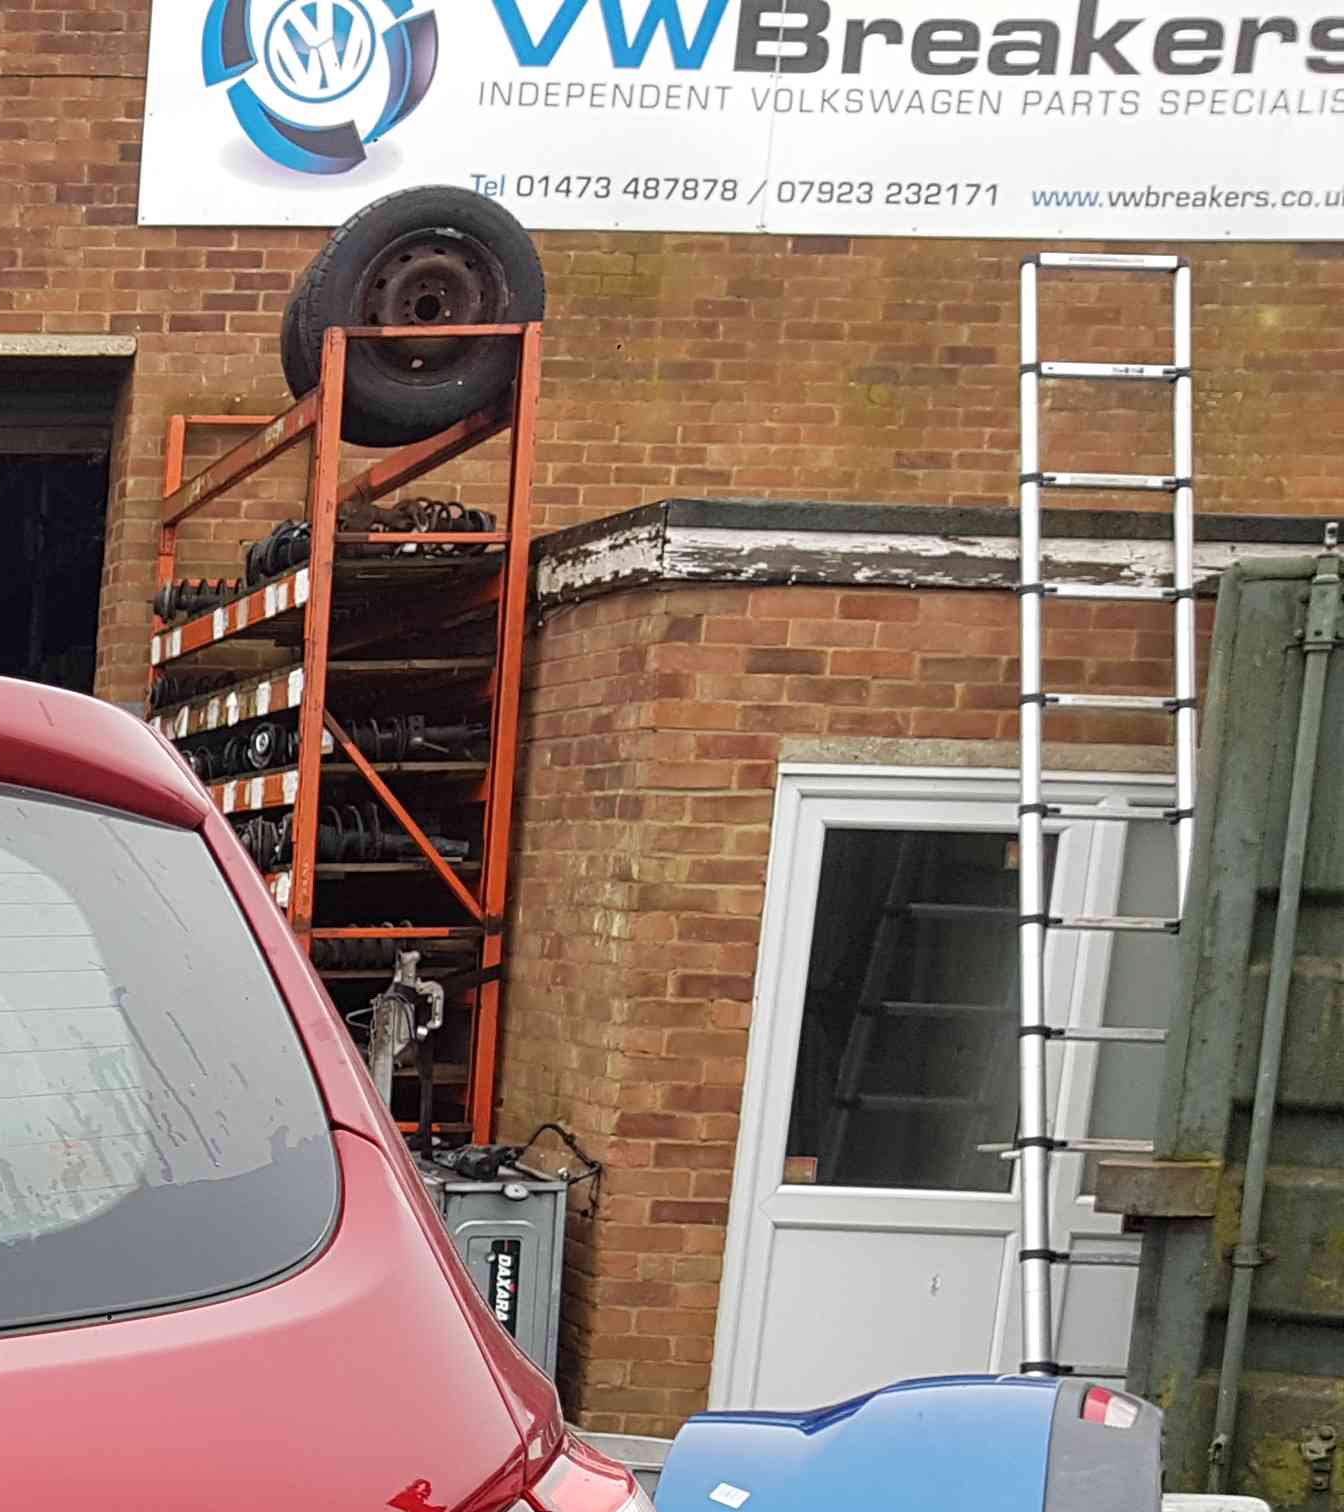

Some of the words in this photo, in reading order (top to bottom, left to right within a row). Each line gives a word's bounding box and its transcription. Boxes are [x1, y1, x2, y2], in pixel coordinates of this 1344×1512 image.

[479, 82, 732, 111] INDEPENDENT
[751, 88, 1002, 115] VOLKSWAGEN
[1021, 90, 1140, 116] PARTS
[470, 174, 506, 196] Tel
[516, 175, 612, 199] 01473
[621, 177, 739, 202] 487878
[776, 181, 874, 205] 07923
[884, 182, 998, 207] 232171
[1031, 185, 1344, 208] www.vwbreakers.co.u
[495, 1254, 512, 1321] DAXARA
